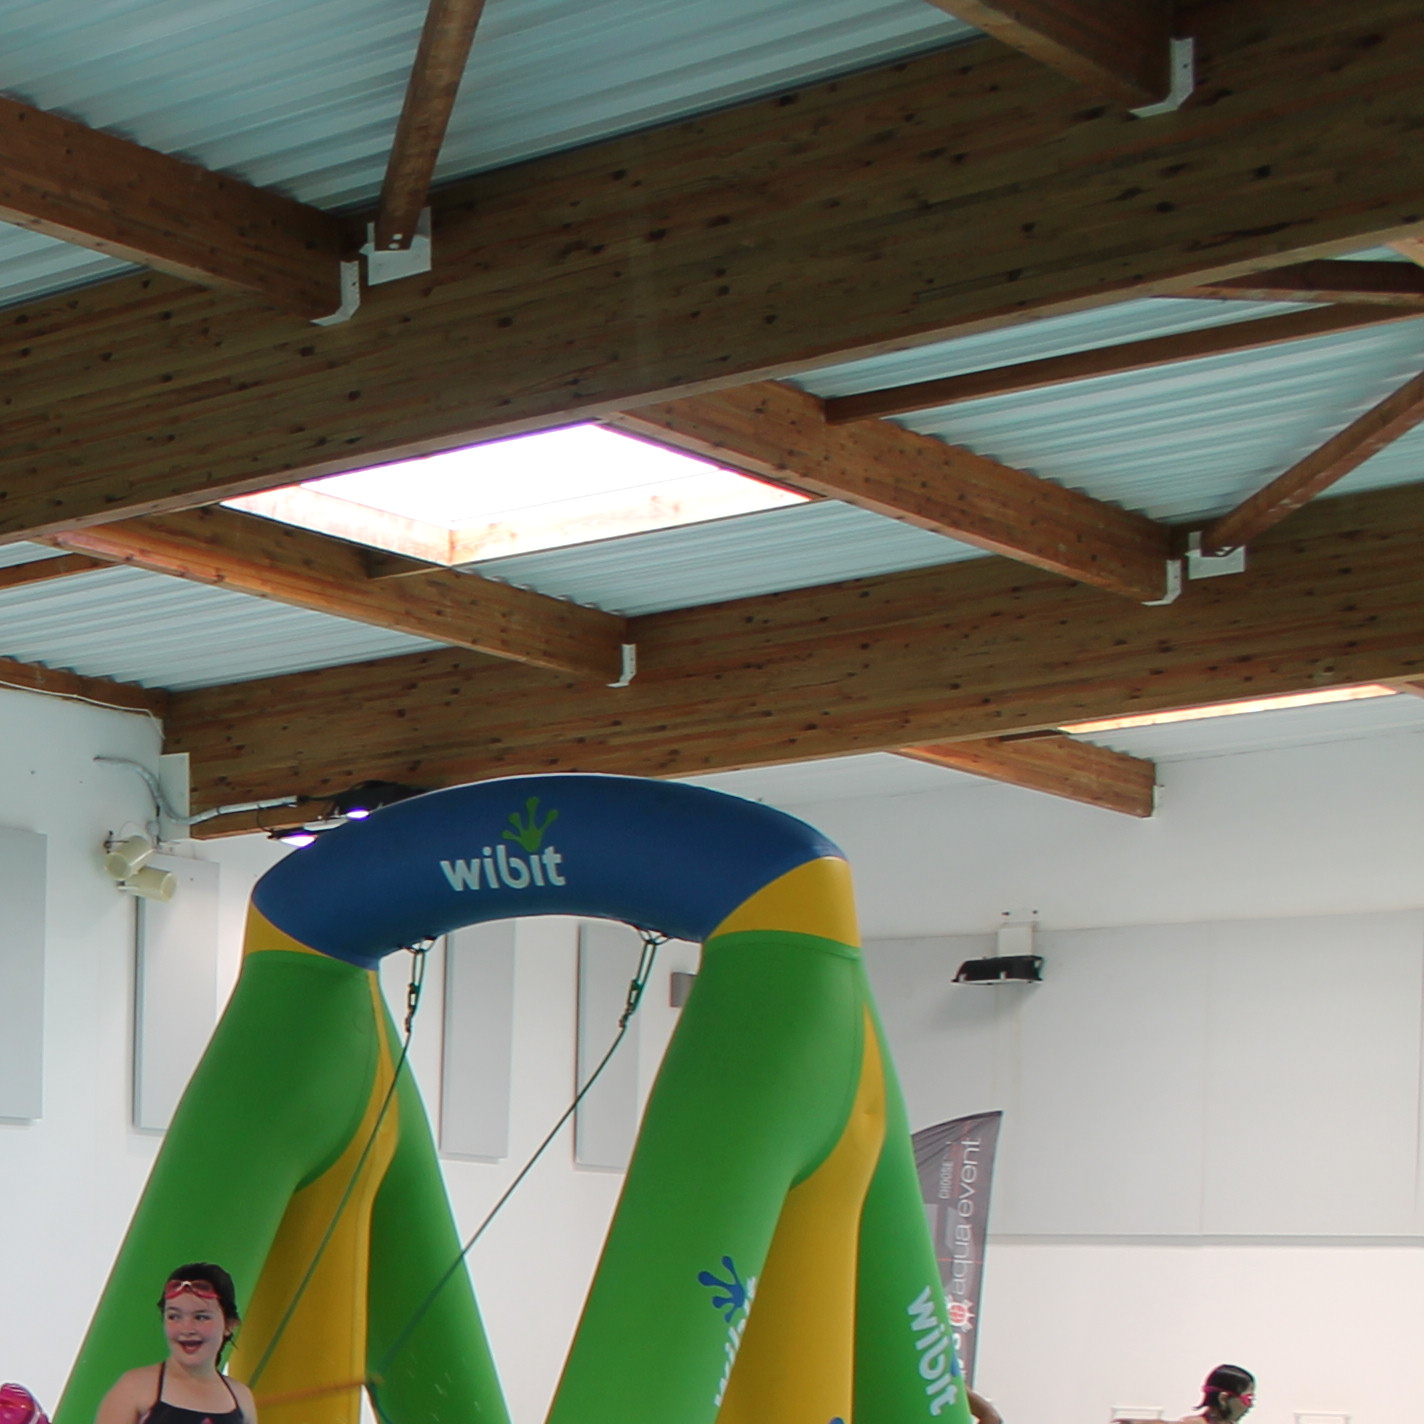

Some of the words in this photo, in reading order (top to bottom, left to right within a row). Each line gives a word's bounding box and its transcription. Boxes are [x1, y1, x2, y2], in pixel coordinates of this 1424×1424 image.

[439, 844, 566, 892] wibit
[957, 1136, 982, 1218] event
[951, 1223, 975, 1296] aqua
[907, 1284, 958, 1417] wibit
